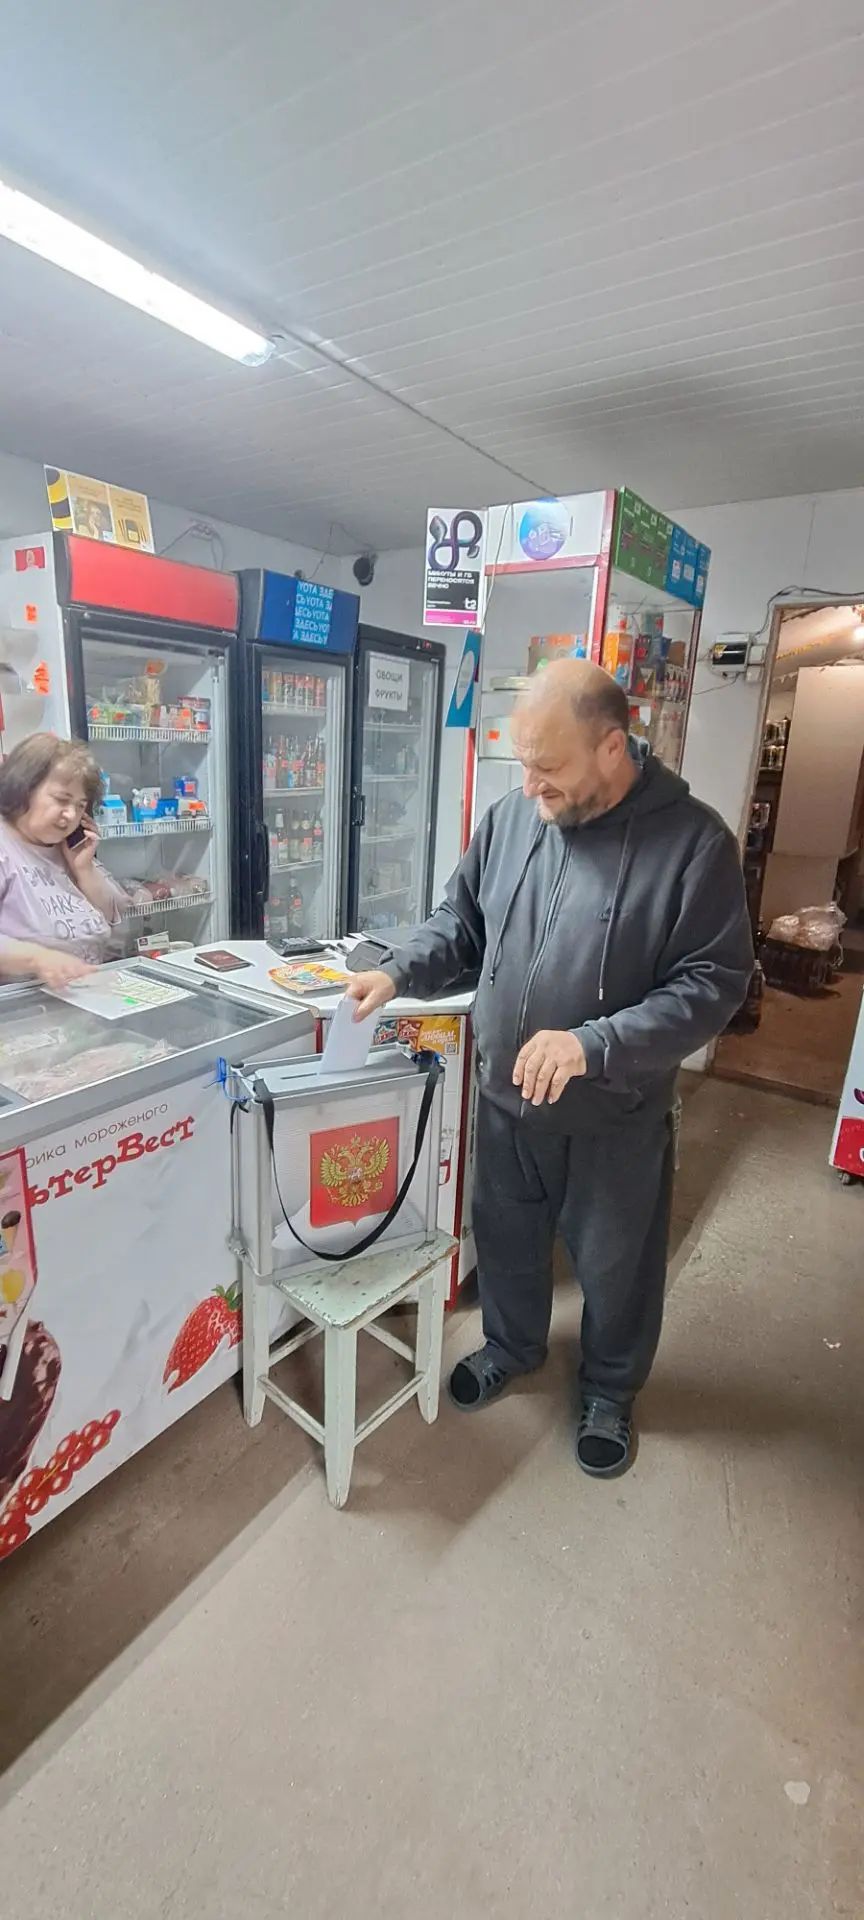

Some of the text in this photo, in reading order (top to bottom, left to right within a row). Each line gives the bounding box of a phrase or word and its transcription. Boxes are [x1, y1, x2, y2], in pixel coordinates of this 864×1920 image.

[428, 576, 474, 584] ПЕРЕНОСЯТСЯ
[298, 581, 317, 594] YOTA
[465, 597, 476, 609] t2
[376, 669, 403, 682] ОВОЩИ
[375, 688, 403, 701] ФРУКТЫ
[74, 1103, 168, 1149] мороженого
